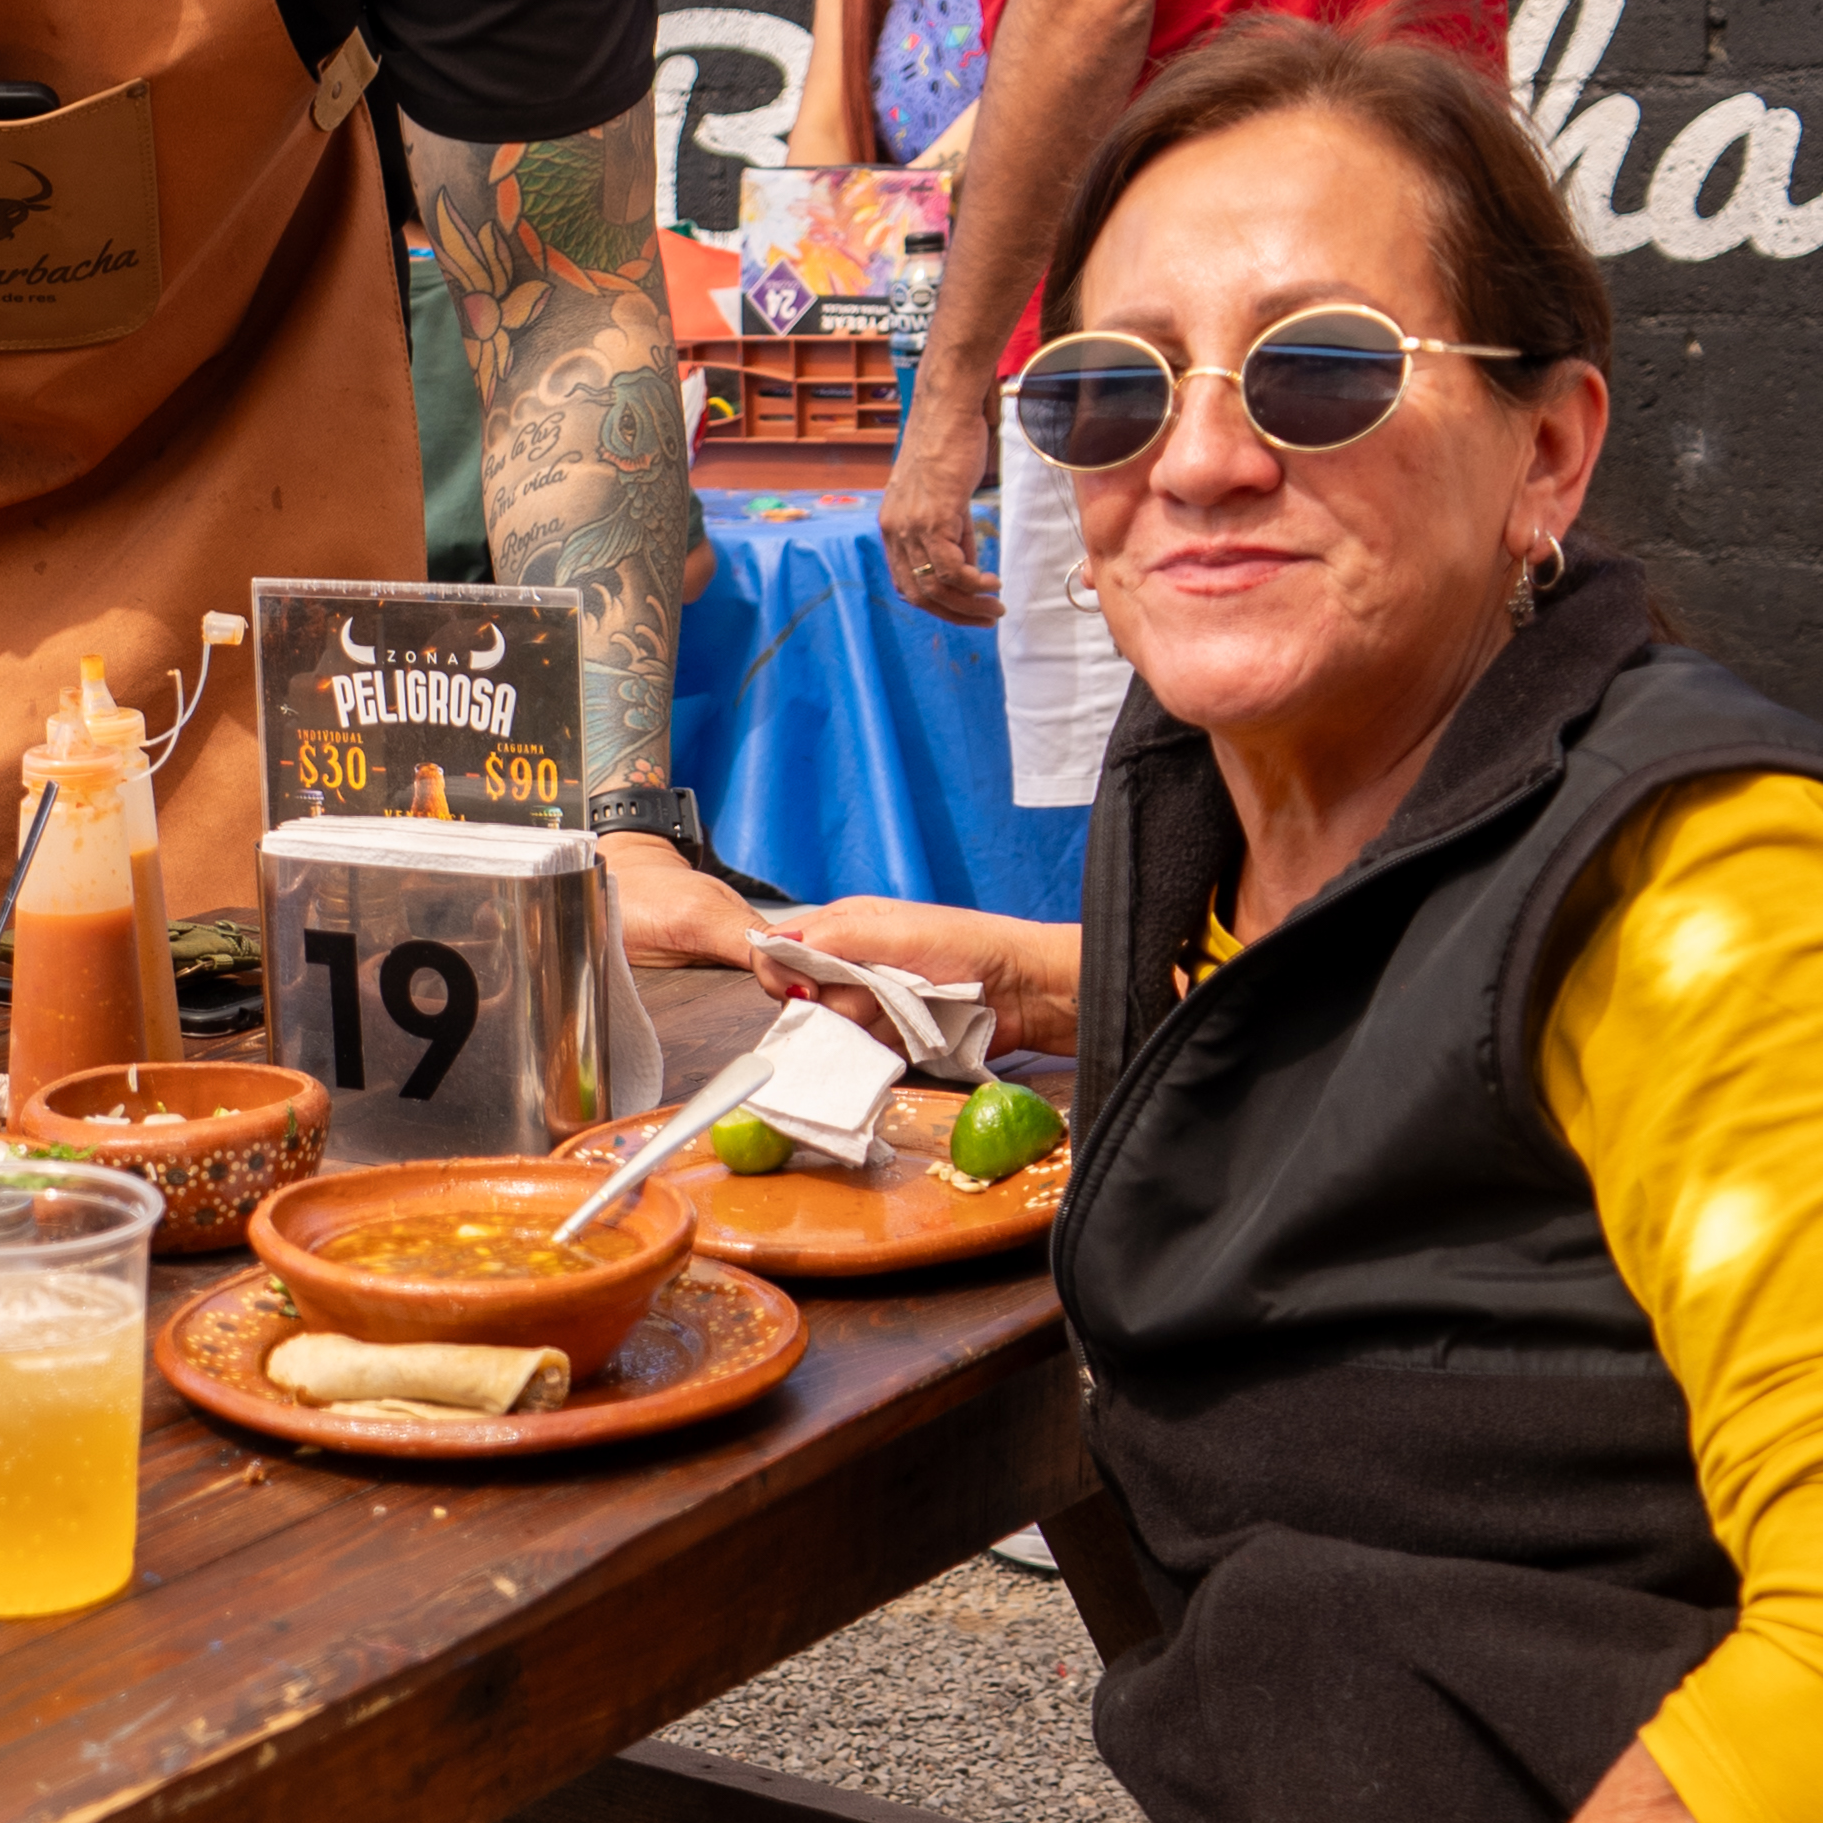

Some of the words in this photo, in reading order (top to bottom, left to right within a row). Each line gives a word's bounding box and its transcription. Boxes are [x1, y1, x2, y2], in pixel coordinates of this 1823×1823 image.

[1, 292, 23, 304] de
[29, 294, 57, 304] res
[523, 450, 583, 496] vida
[386, 649, 460, 666] ZONA
[331, 668, 518, 739] PELIGROSA
[297, 729, 364, 745] INDIVIDUAL
[496, 742, 545, 756] CAGUAMA
[298, 742, 367, 791] $30
[484, 751, 559, 803] $90
[303, 928, 479, 1101] 19
